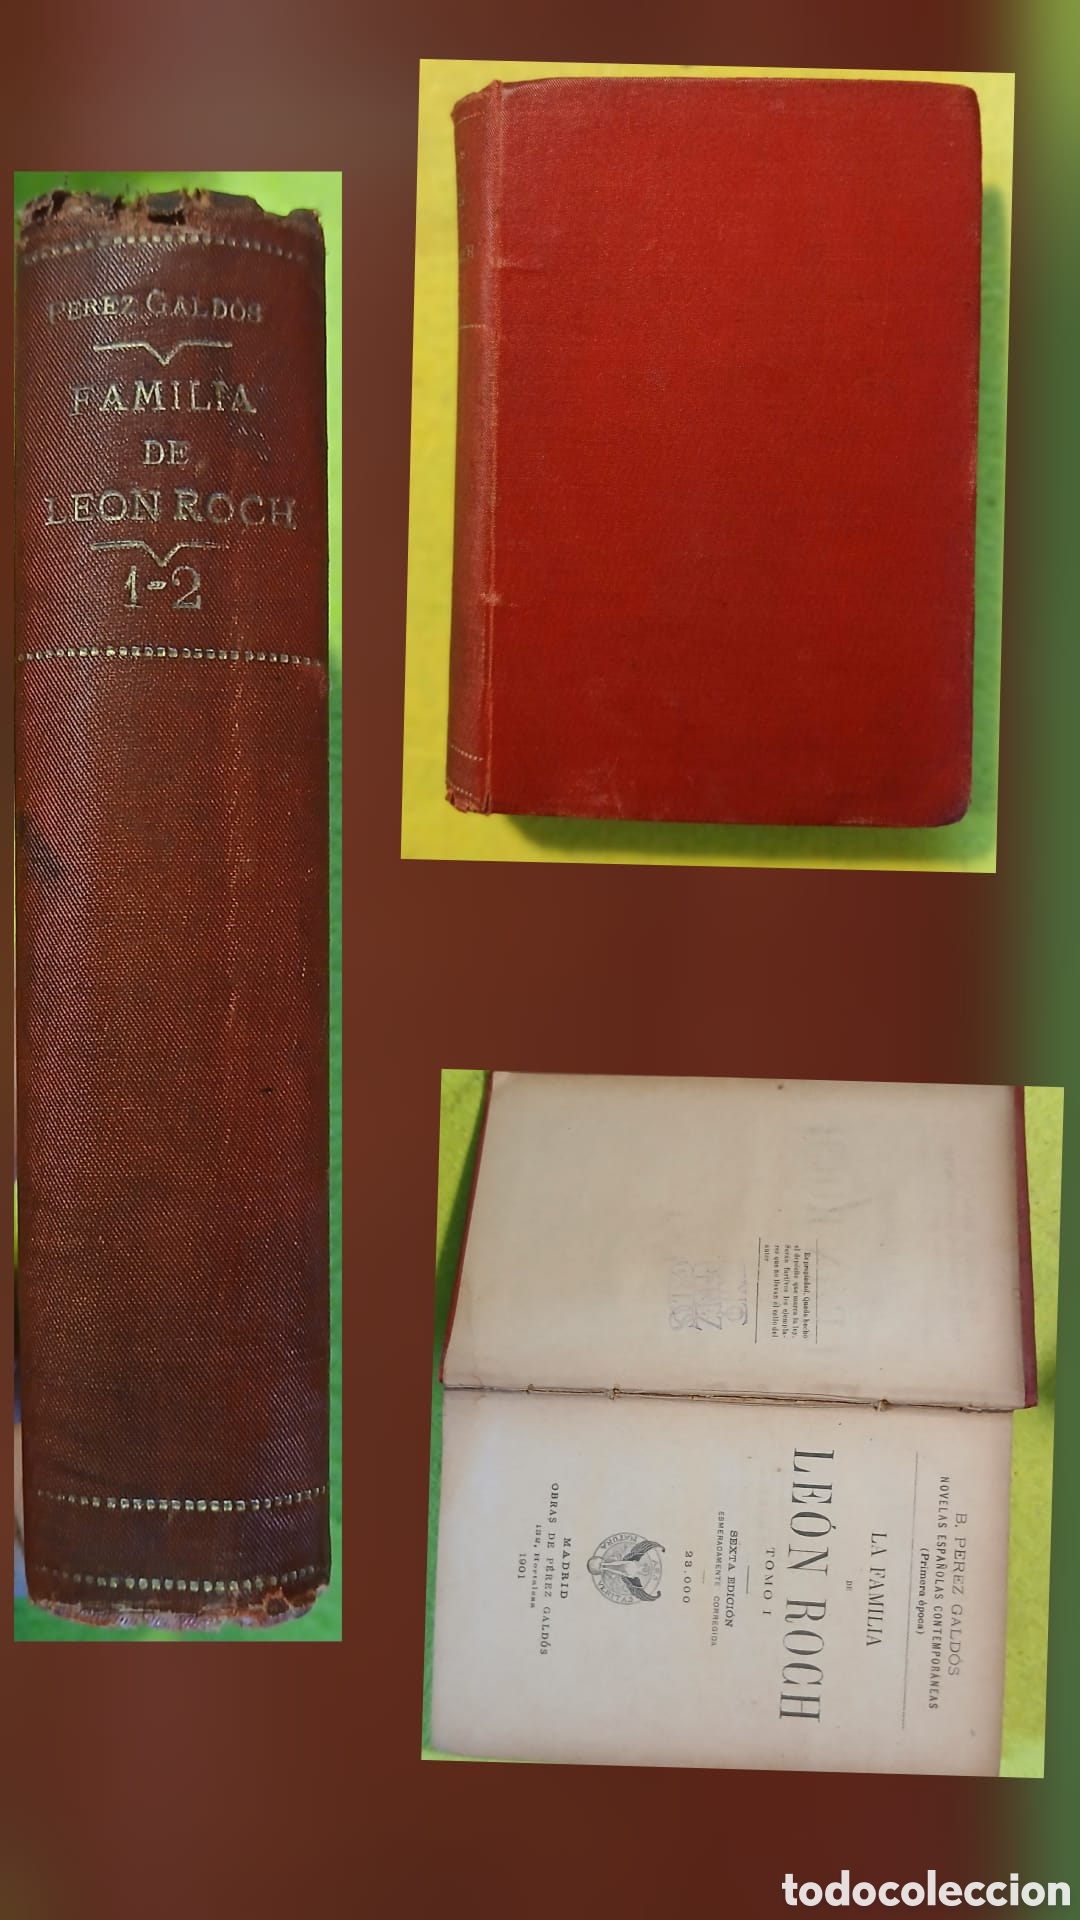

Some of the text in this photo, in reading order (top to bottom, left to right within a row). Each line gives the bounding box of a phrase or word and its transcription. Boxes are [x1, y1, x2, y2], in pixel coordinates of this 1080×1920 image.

[69, 379, 257, 416] FAMILIA
[143, 439, 190, 465] DE
[174, 488, 297, 530] ROCH
[124, 565, 202, 609] 1-2
[938, 1476, 950, 1528] NOVELAS
[954, 1513, 968, 1528] B.
[518, 1552, 526, 1579] 1901
[540, 1483, 560, 1655] OBRAS DE PÉREZ GALDÓS
[560, 1537, 572, 1600] MADRID
[682, 1550, 694, 1604] 23.000
[724, 1530, 738, 1628] SEXTA EDICIÓN
[762, 1547, 775, 1600] TOMO
[780, 1448, 836, 1724] LEÓN ROCH
[846, 1580, 853, 1592] DE
[866, 1533, 887, 1646] LA FAMILIA
[918, 1548, 930, 1597] (Primera
[934, 1534, 948, 1600] ESPAÑOLAS
[948, 1604, 964, 1677] GALDÓS
